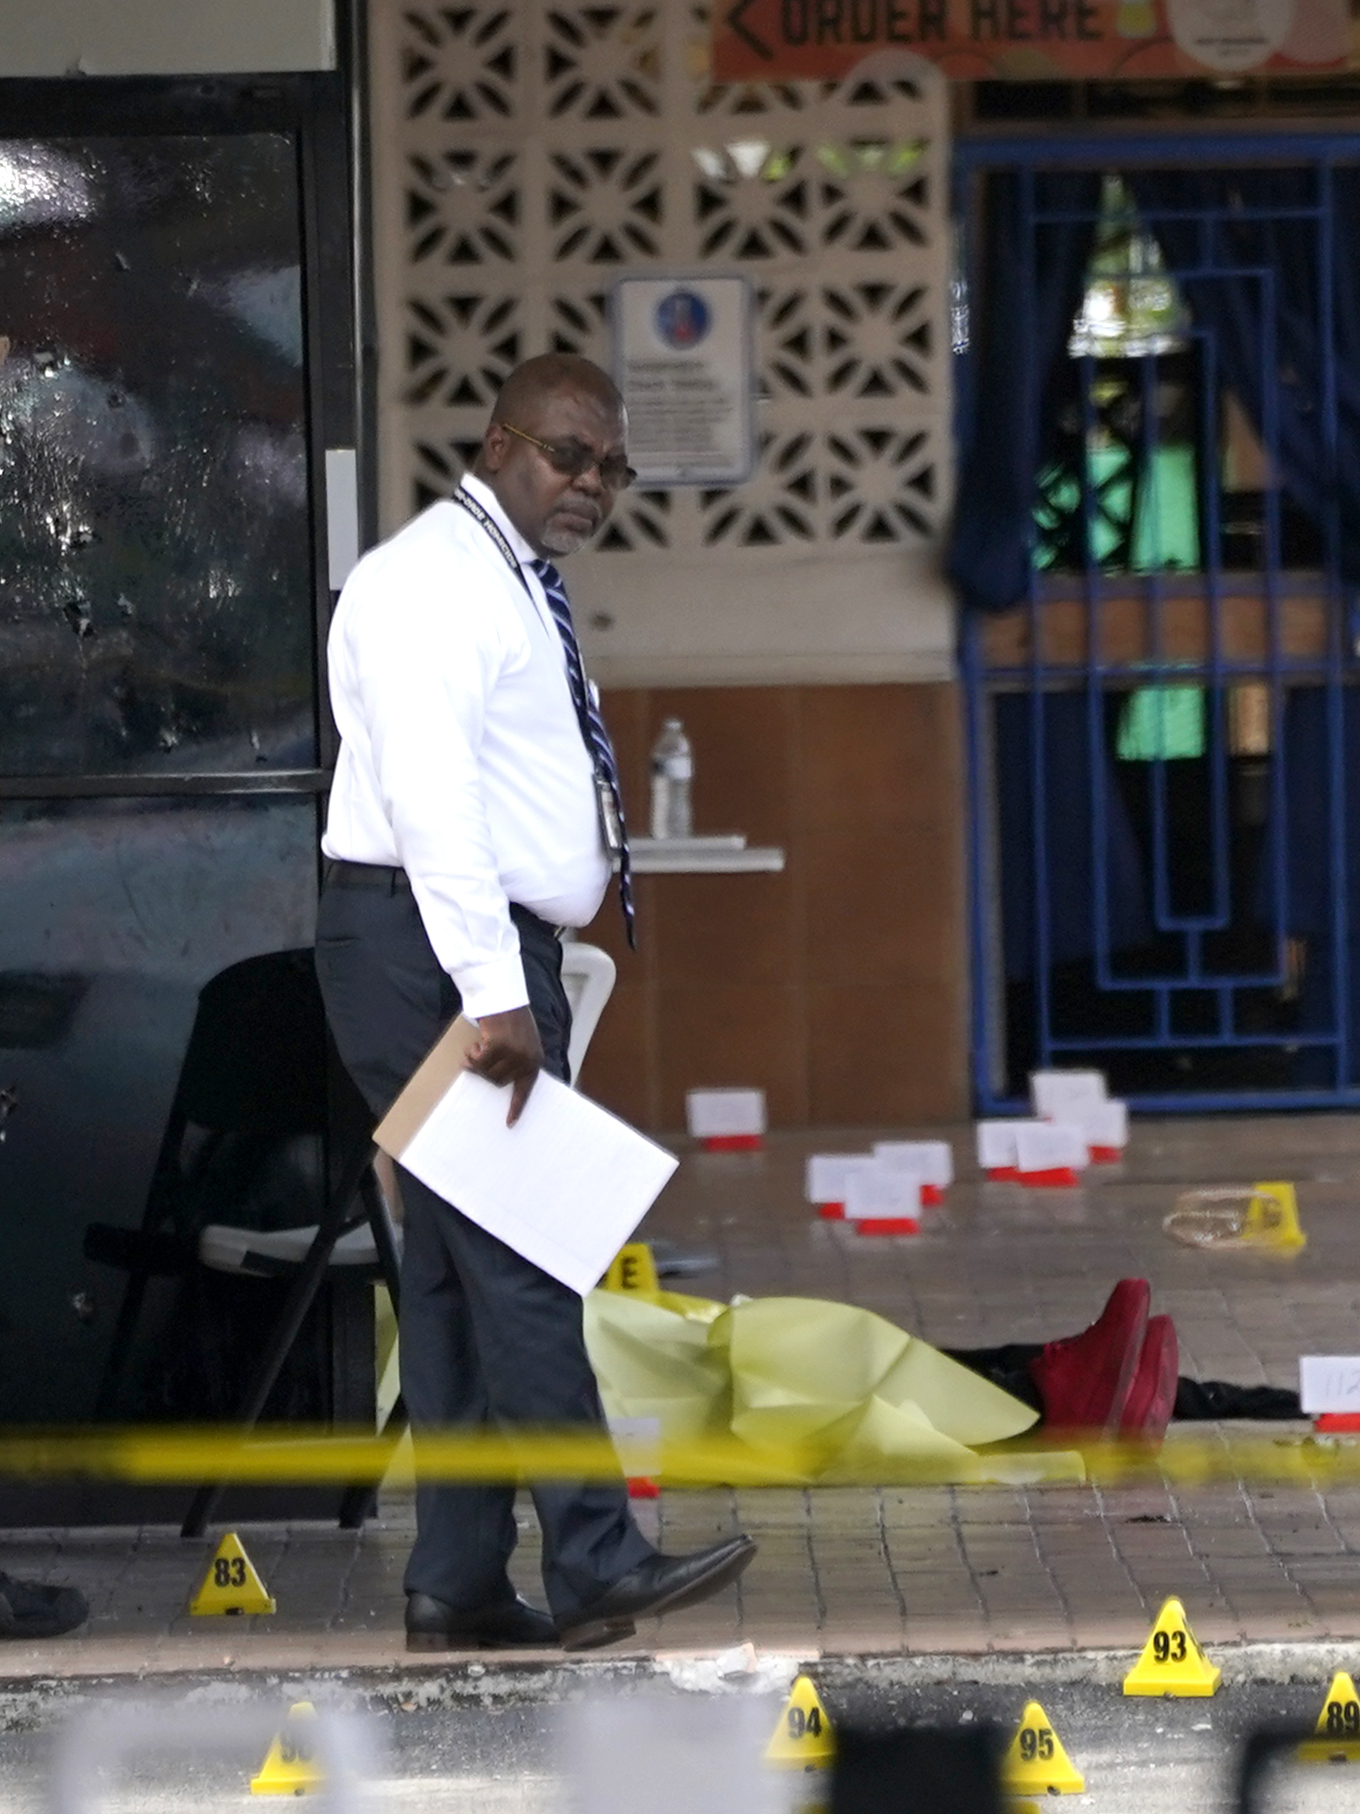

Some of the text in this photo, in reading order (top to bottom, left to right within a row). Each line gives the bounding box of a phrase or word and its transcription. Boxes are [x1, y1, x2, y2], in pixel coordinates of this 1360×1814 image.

[781, 0, 1104, 46] ORDER HERE
[483, 517, 518, 569] HOMICIDE
[214, 1557, 246, 1588] 83
[1152, 1630, 1188, 1664] 93
[787, 1706, 823, 1740] 94
[1326, 1700, 1360, 1735] 89
[1020, 1727, 1055, 1761] 95
